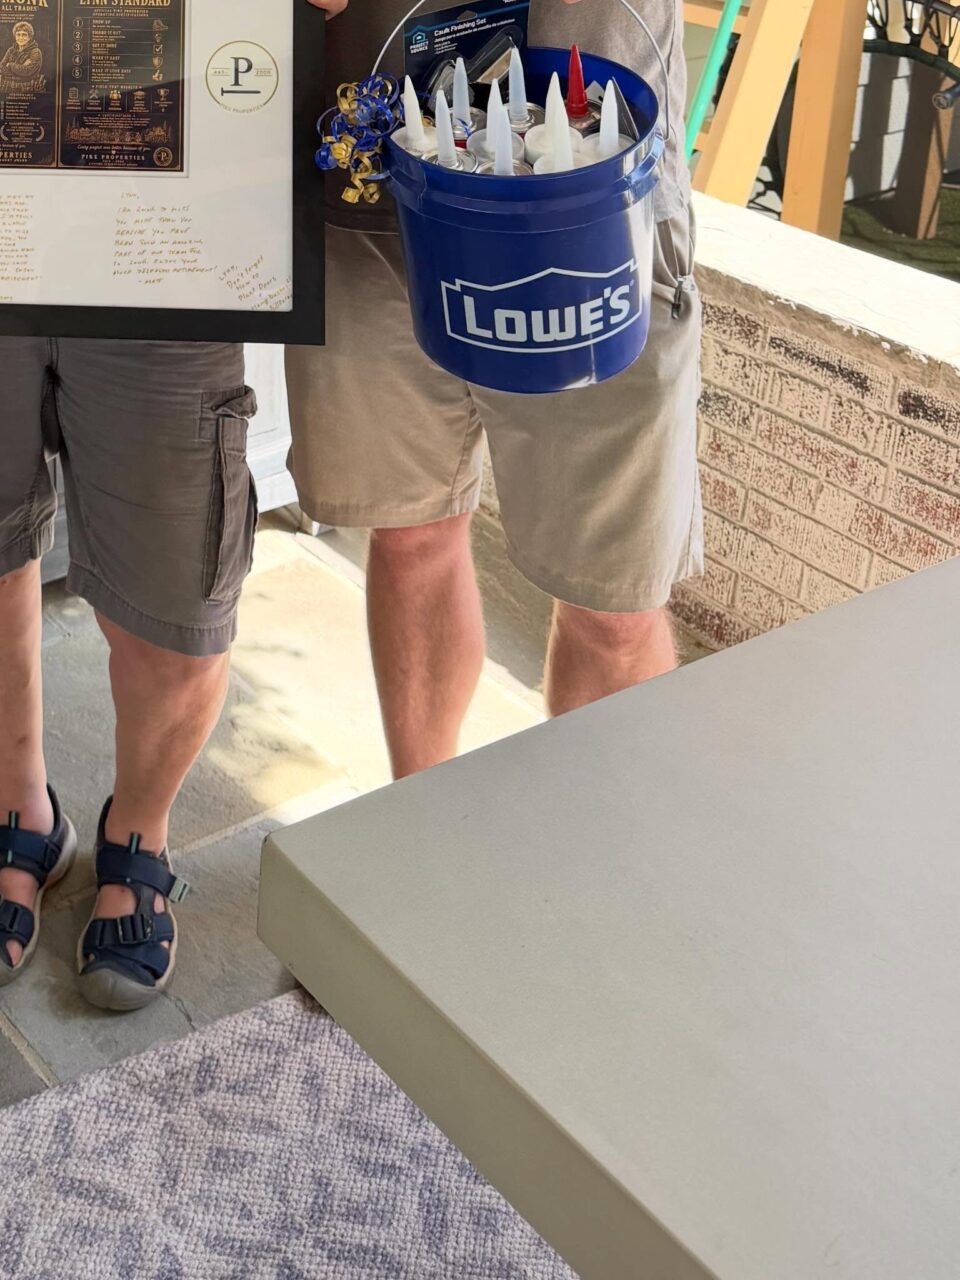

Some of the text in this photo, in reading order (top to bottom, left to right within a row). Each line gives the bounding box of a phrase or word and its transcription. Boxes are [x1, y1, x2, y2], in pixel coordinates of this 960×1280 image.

[450, 20, 476, 33] Finishing
[475, 18, 487, 26] Set
[229, 56, 253, 87] P
[463, 284, 630, 343] LOWE'S
